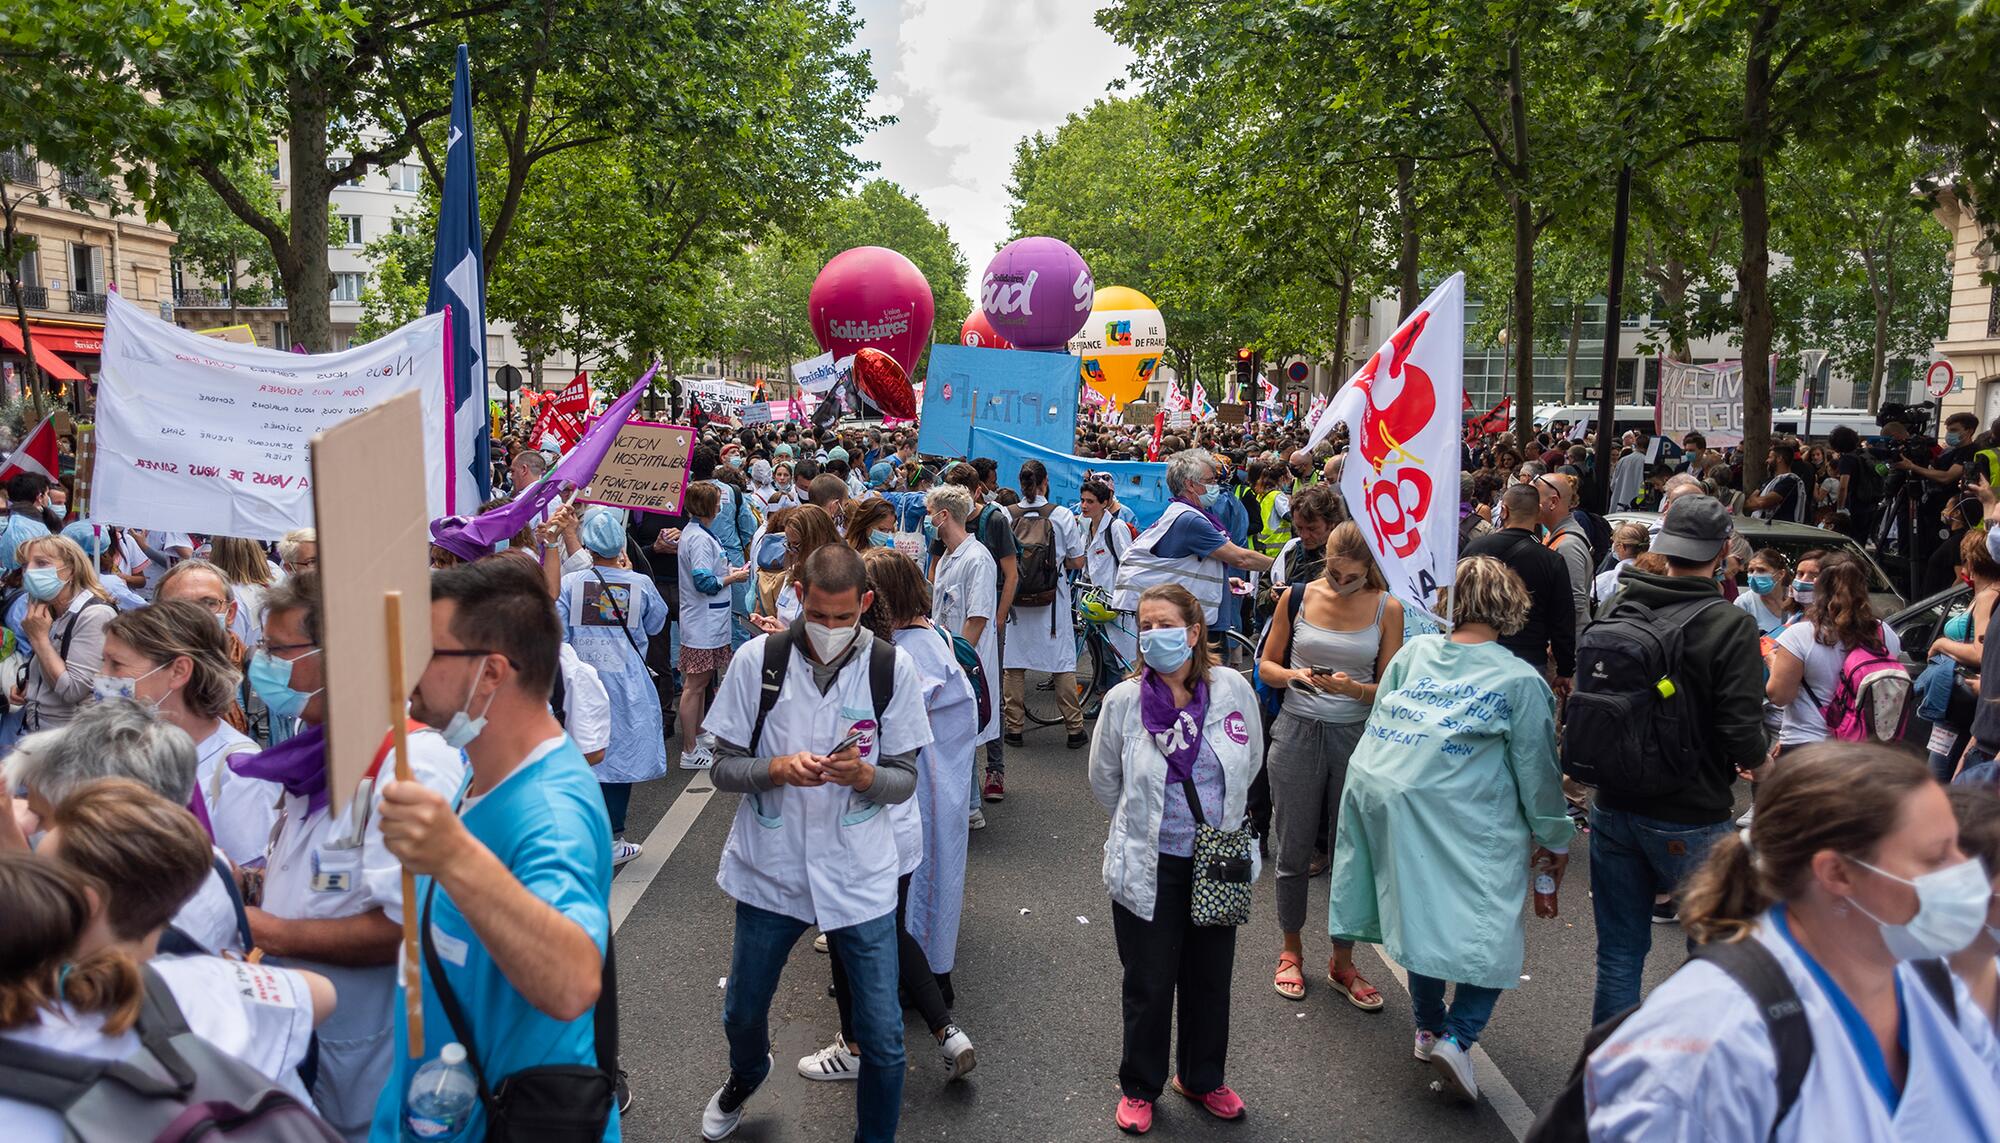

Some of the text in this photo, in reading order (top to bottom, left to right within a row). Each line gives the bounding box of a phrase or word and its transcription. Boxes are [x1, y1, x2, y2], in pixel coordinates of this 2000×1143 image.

[829, 318, 908, 339] Solidaires
[1148, 326, 1158, 335] ILE
[74, 340, 94, 349] Service
[1135, 339, 1144, 347] DE
[600, 475, 650, 492] FONCTION
[651, 481, 669, 491] LA
[599, 489, 623, 502] MAL
[1391, 704, 1426, 722] VOUS
